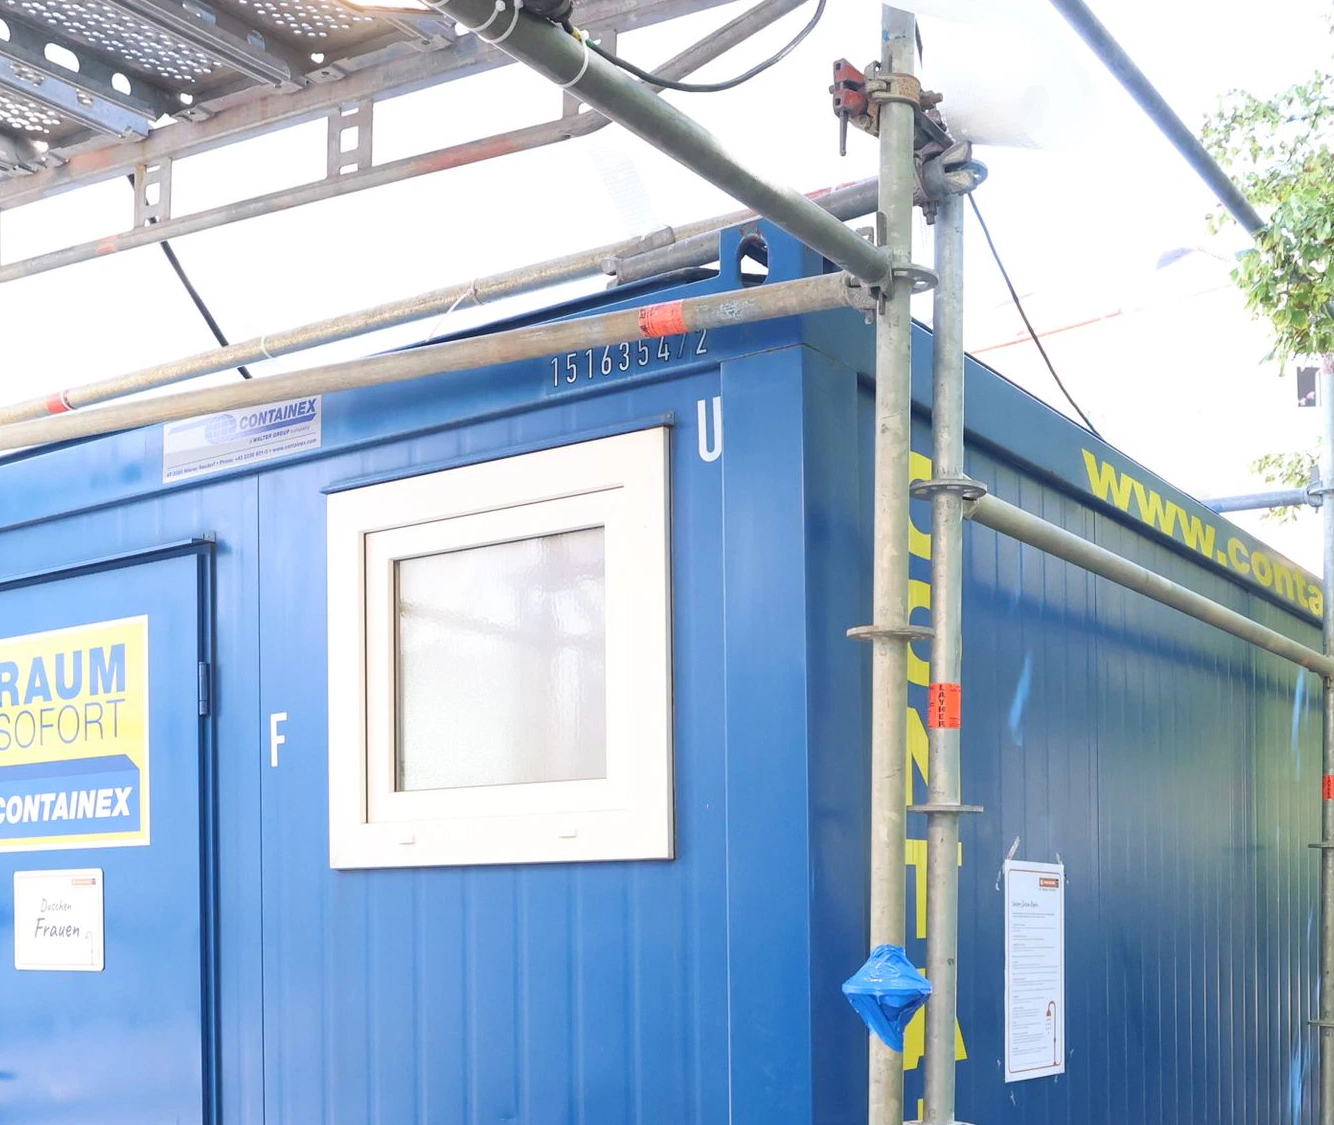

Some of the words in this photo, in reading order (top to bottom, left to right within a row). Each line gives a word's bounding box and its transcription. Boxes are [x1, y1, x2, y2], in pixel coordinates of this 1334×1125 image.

[239, 398, 317, 430] CONTAINEX
[273, 429, 290, 438] GROUP
[697, 396, 723, 462] U
[270, 711, 288, 767] F
[40, 898, 72, 913] Duschen
[35, 917, 80, 938] Frauen
